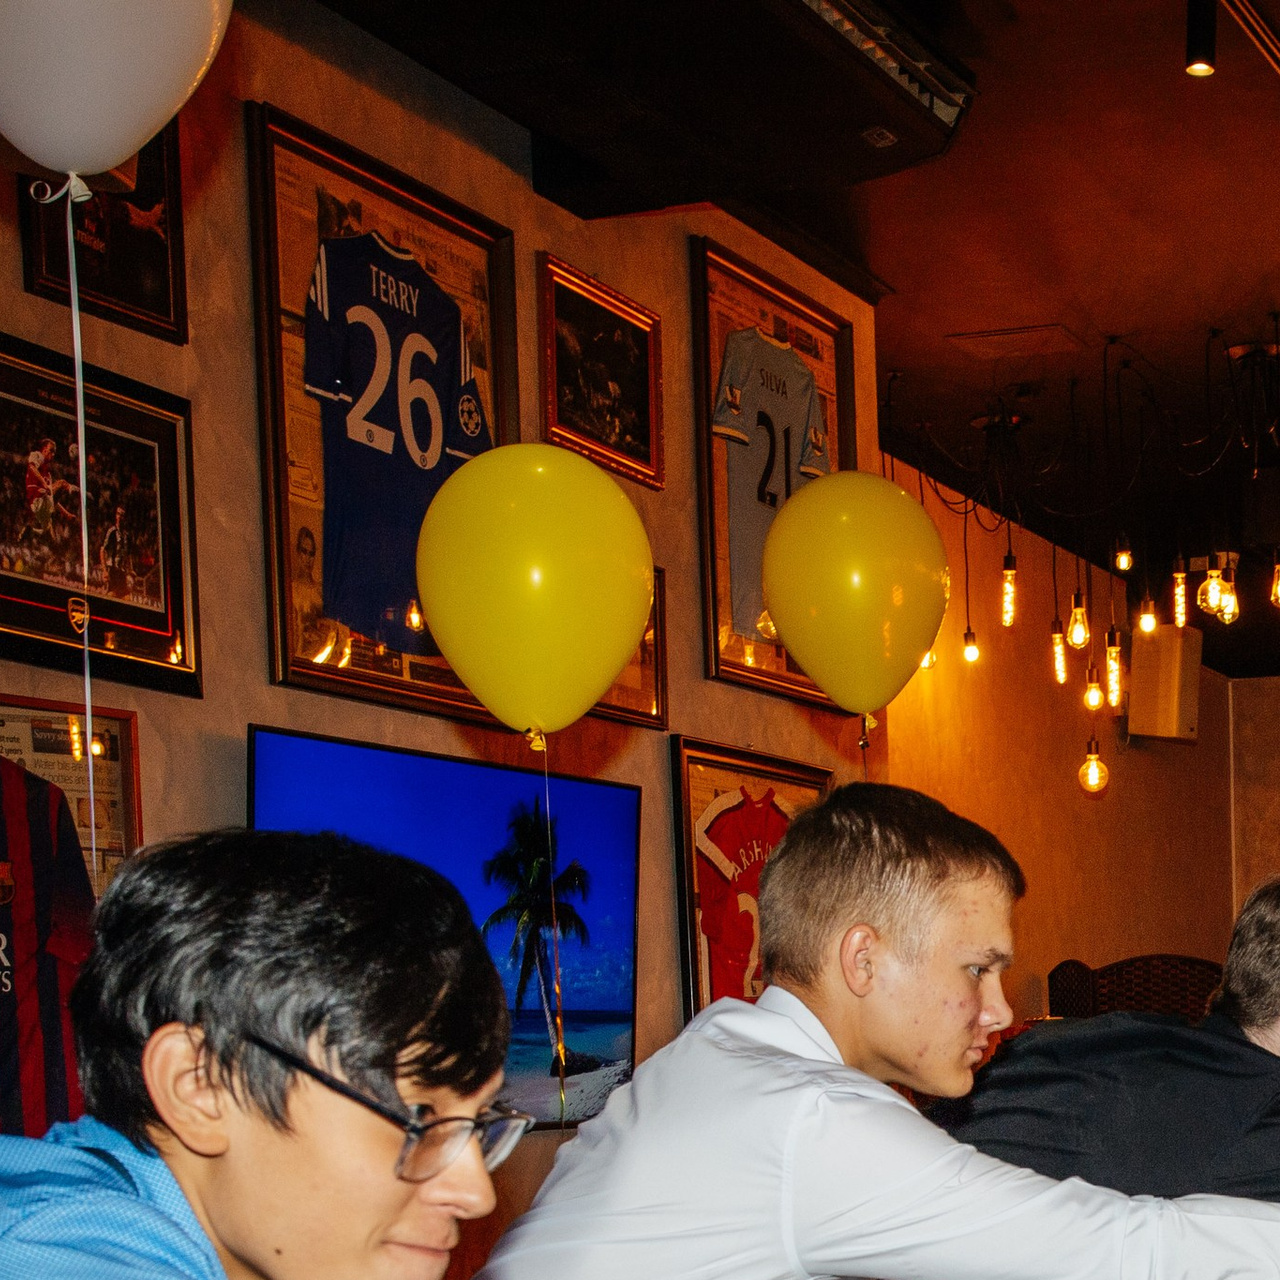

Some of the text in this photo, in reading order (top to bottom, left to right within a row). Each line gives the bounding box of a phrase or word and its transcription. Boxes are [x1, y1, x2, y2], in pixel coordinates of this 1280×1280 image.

[369, 263, 420, 318] TERRY
[345, 304, 443, 470] 26
[759, 367, 788, 399] SILVA
[756, 411, 793, 509] 21
[737, 893, 764, 998] 2
